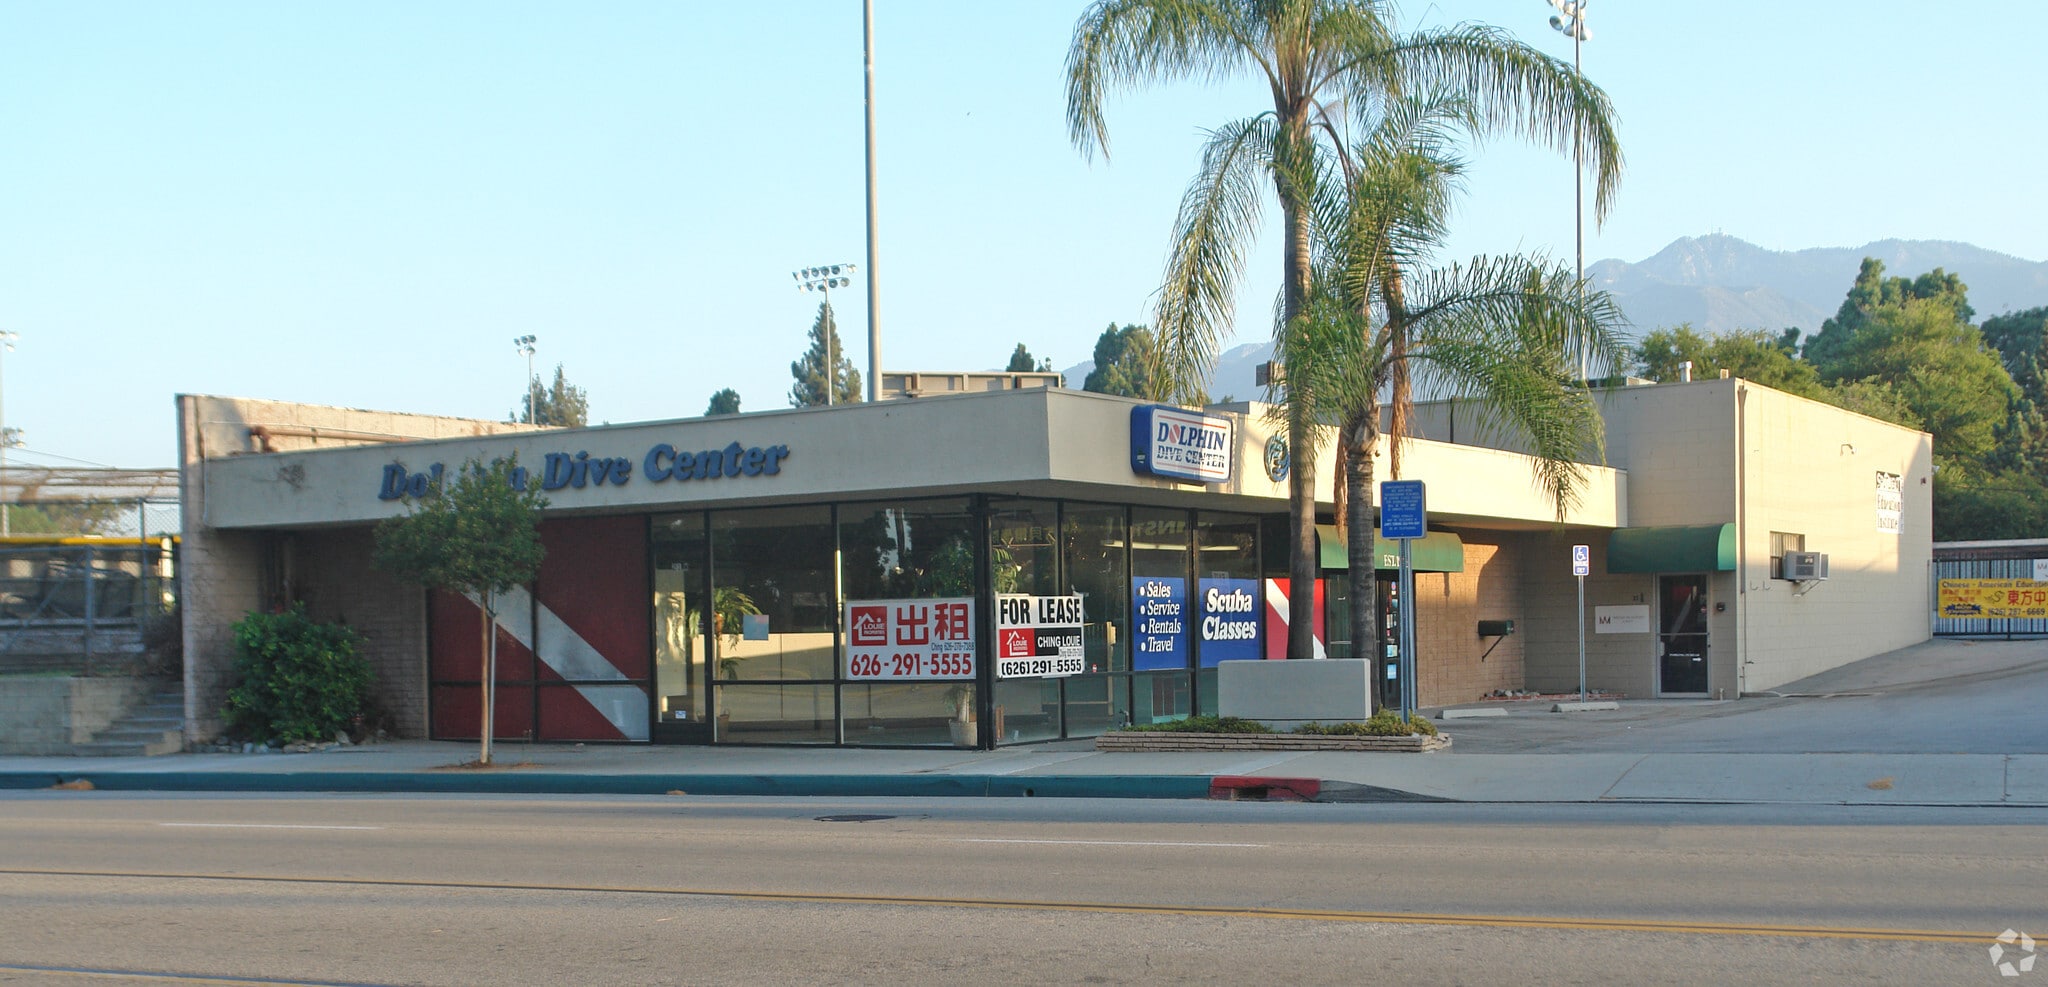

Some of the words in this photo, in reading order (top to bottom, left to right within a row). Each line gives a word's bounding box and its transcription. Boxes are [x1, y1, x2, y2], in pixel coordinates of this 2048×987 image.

[1157, 421, 1226, 450] DOLPHIN
[542, 450, 632, 490] Dive
[643, 440, 790, 483] Center
[1156, 445, 1183, 462] DIVE
[1185, 450, 1225, 468] CENTER
[1146, 580, 1172, 598] Sales
[1206, 587, 1253, 613] Scuba
[1000, 598, 1031, 625] FOR
[1038, 598, 1081, 624] LEASE
[1147, 600, 1180, 616] Service
[896, 603, 970, 645] 出租
[1147, 618, 1182, 634] Rentals
[1202, 616, 1257, 641] Classes
[1037, 636, 1061, 648] CHING
[1062, 635, 1081, 647] LOUIE
[1147, 637, 1174, 652] Travel
[851, 653, 972, 676] 626-291-5555
